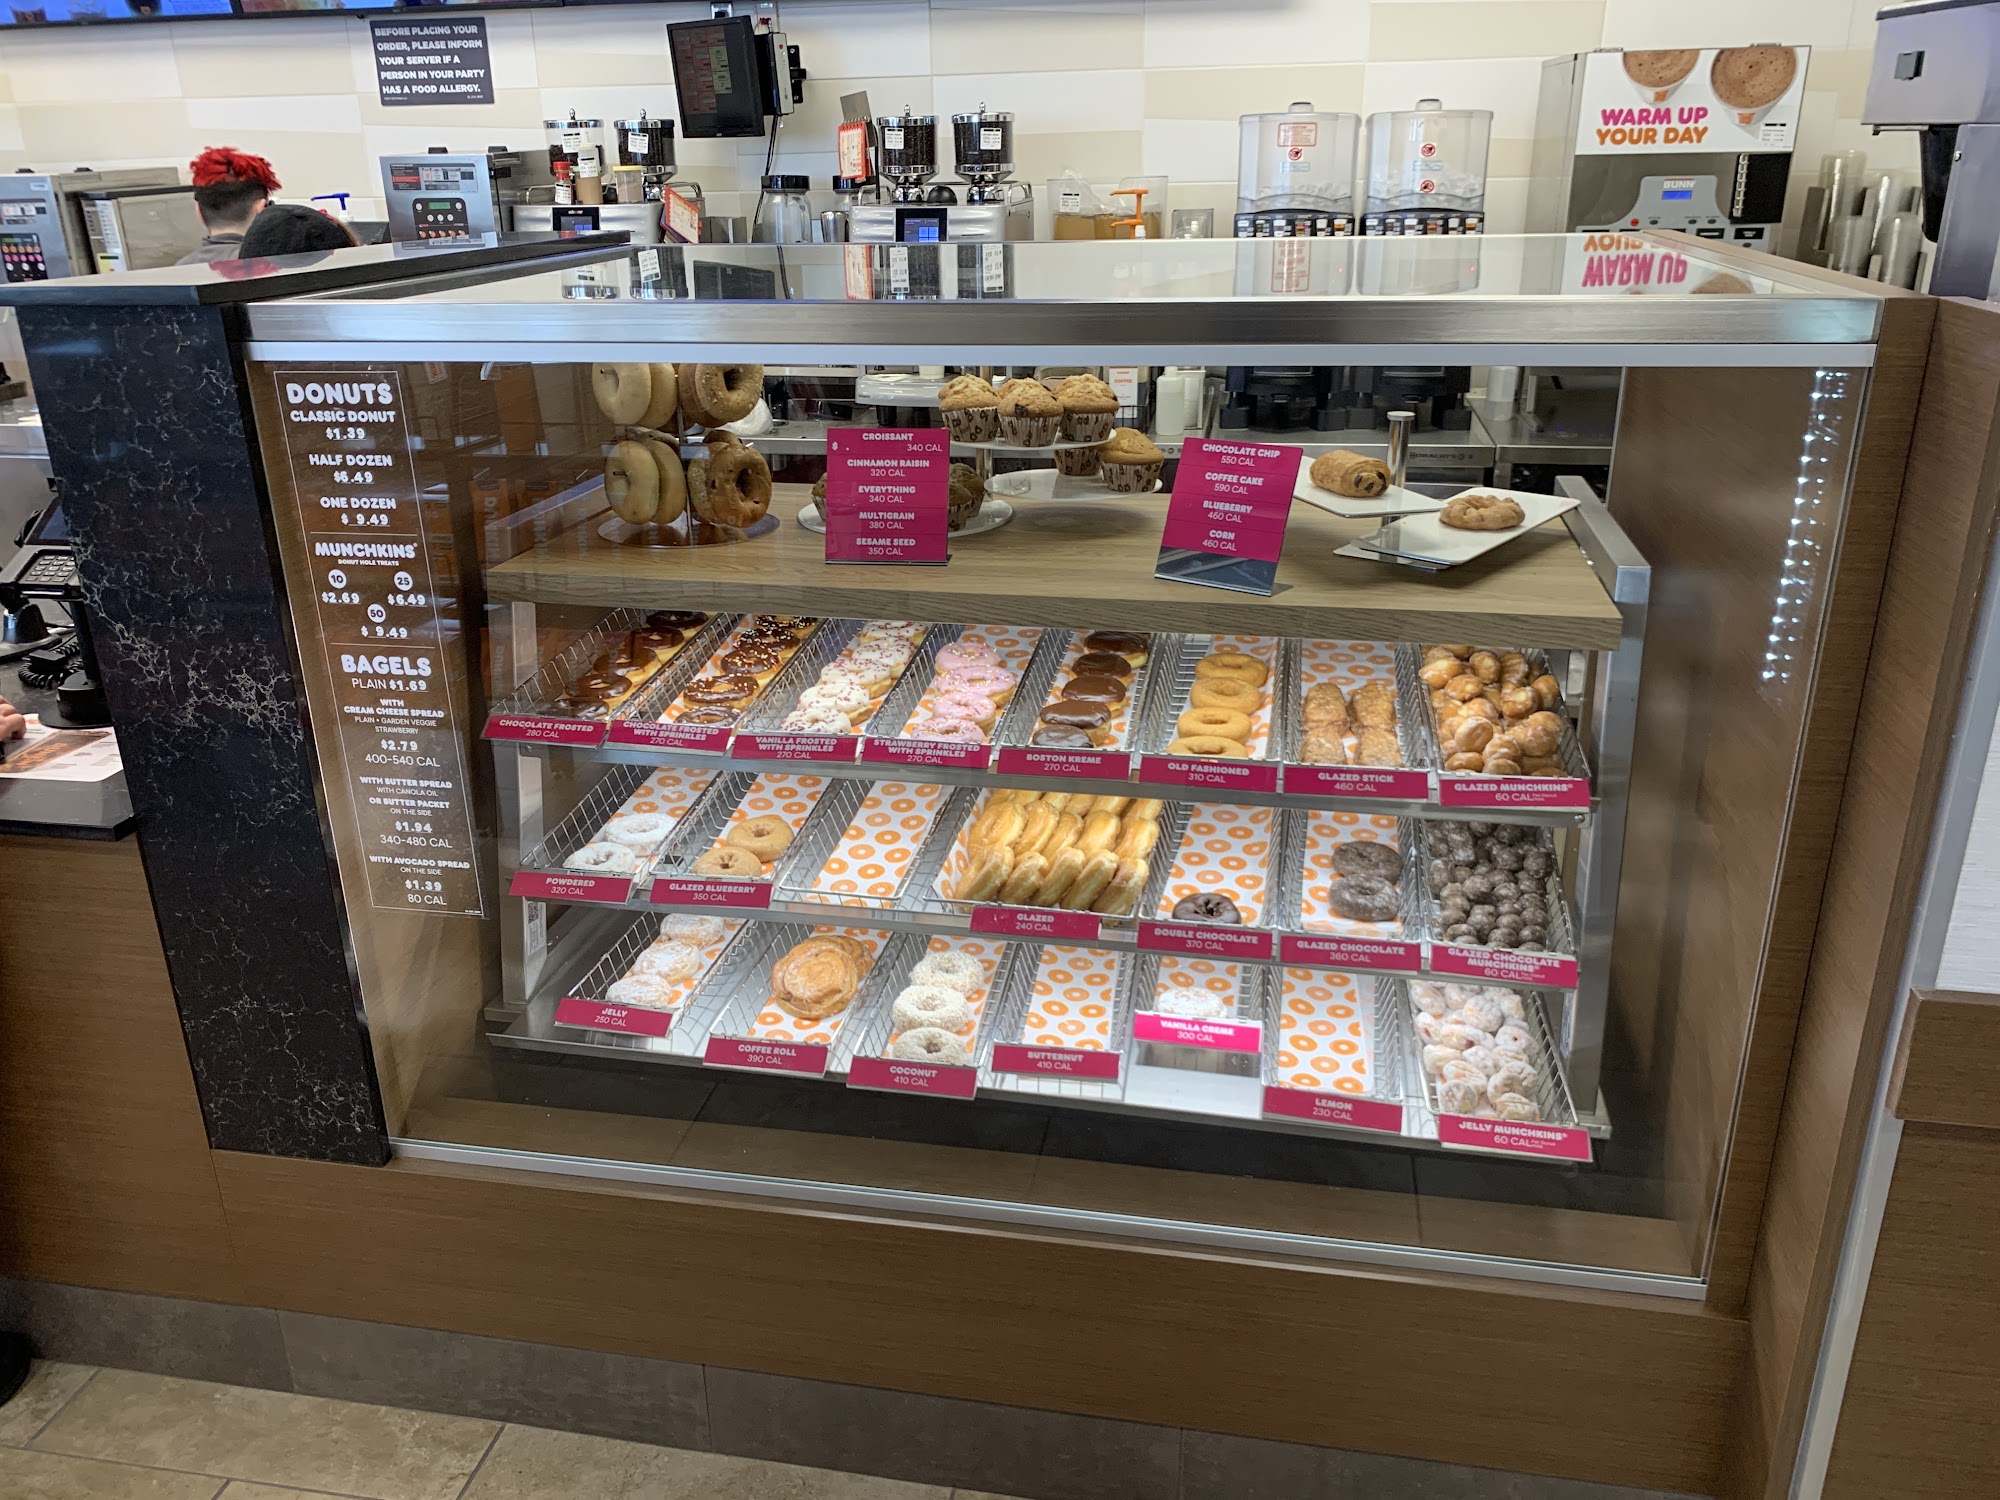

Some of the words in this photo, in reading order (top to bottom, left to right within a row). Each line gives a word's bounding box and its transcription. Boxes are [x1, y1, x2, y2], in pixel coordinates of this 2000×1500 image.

[375, 27, 410, 36] BEFORE
[412, 26, 450, 35] PLACING
[453, 25, 478, 33] YOUR
[377, 42, 410, 51] ORDER,
[412, 41, 446, 49] PLEASE
[448, 40, 482, 48] INFORM
[379, 57, 404, 65] YOUR
[406, 55, 441, 64] SERVER
[443, 55, 451, 63] IF
[453, 55, 460, 63] A
[380, 71, 416, 80] PERSON
[418, 71, 427, 79] IN
[429, 70, 454, 78] YOUR
[456, 70, 484, 78] PARTY
[382, 85, 401, 94] HAS
[403, 85, 410, 93] A
[412, 85, 437, 93] FOOD
[440, 84, 480, 93] ALLERGY.
[1601, 108, 1671, 126] WARM
[1678, 107, 1708, 124] UP
[1596, 128, 1657, 145] YOUR
[1663, 127, 1709, 143] DAY
[286, 383, 392, 405] DONUTS
[290, 411, 345, 422] CLASSIC
[348, 411, 395, 422] DONUT
[1203, 444, 1256, 456] CHOCOLATE
[1258, 449, 1280, 458] CHIP
[309, 454, 343, 465] HALF
[346, 455, 392, 466] DOZEN
[847, 459, 898, 467] CINNAMON
[1221, 456, 1237, 464] 550
[1238, 457, 1255, 466] CAL
[1205, 472, 1238, 483] COFFEE
[1240, 476, 1263, 486] CAKE
[1214, 483, 1230, 492] 590
[1232, 485, 1248, 494] CAL
[320, 498, 348, 508] ONE
[351, 498, 396, 509] DOZEN
[1203, 500, 1253, 513] BLUEBERRY
[859, 512, 914, 520] MULTIGRAIN
[1208, 512, 1224, 520] 460
[1225, 514, 1242, 522] CAL
[1210, 530, 1235, 540] CORN
[856, 538, 891, 546] SESAME
[1202, 539, 1218, 548] 460
[1220, 542, 1237, 551] CAL
[341, 655, 431, 676] BAGELS
[352, 678, 386, 689] PLAIN
[380, 698, 404, 706] WITH
[344, 706, 375, 715] CREAM
[376, 707, 409, 716] CHEESE
[411, 708, 444, 718] SPREAD
[499, 720, 552, 730] CHOCOLATE
[554, 723, 593, 732] FROSTED
[623, 721, 676, 732] CHOCOLATE
[678, 726, 718, 735] FROSTED
[634, 728, 657, 737] WITH
[659, 730, 706, 741] SPRINKLES
[796, 737, 837, 745] FROSTED
[874, 739, 941, 749] STRAWBERRY
[943, 742, 980, 752] FROSTED
[785, 744, 834, 752] SPRINKLES
[915, 748, 966, 758] SPRINKLES
[365, 754, 413, 767] 400-540
[416, 756, 440, 767] CAL
[1026, 754, 1066, 762] BOSTON
[1068, 756, 1101, 764] KREME
[1168, 762, 1189, 772] OLD
[1191, 764, 1249, 776] FASHIONED
[360, 776, 383, 785] WITH
[385, 777, 417, 787] BUTTER
[419, 779, 452, 789] SPREAD
[1318, 772, 1360, 782] GLAZED
[1362, 774, 1394, 783] STICK
[1454, 783, 1497, 791] GLAZED
[369, 797, 382, 805] OR
[383, 798, 416, 807] BUTTER
[418, 800, 450, 809] PACKET
[380, 835, 426, 847] 340-480
[430, 836, 452, 848] CAL
[369, 855, 392, 863] WITH
[394, 857, 436, 866] AVOCADO
[438, 860, 470, 869] SPREAD
[546, 877, 595, 888] POWDERED
[669, 883, 704, 891] GLAZED
[706, 884, 756, 893] BLUEBERRY
[551, 886, 566, 894] 320
[408, 894, 421, 903] 80
[424, 894, 447, 905] CAL
[1017, 913, 1054, 922] GLAZED
[1154, 928, 1194, 939] DOUBLE
[1196, 931, 1258, 944] CHOCOLATE
[1297, 940, 1338, 950] GLAZED
[1340, 944, 1405, 955] CHOCOLATE
[1448, 948, 1490, 959] GLAZED
[1492, 952, 1560, 967] CHOCOLATE
[602, 1008, 628, 1017] JELLY
[1160, 1020, 1200, 1032] VANILLA
[1202, 1024, 1234, 1036] CREME
[1178, 1031, 1195, 1039] 300
[1197, 1033, 1214, 1042] CAL
[738, 1044, 771, 1054] COFFEE
[773, 1046, 796, 1056] ROLL
[1028, 1051, 1084, 1062] BUTTERNUT
[890, 1065, 937, 1078] COCONUT
[1315, 1098, 1352, 1110] LEMON
[1459, 1121, 1492, 1132] JELLY
